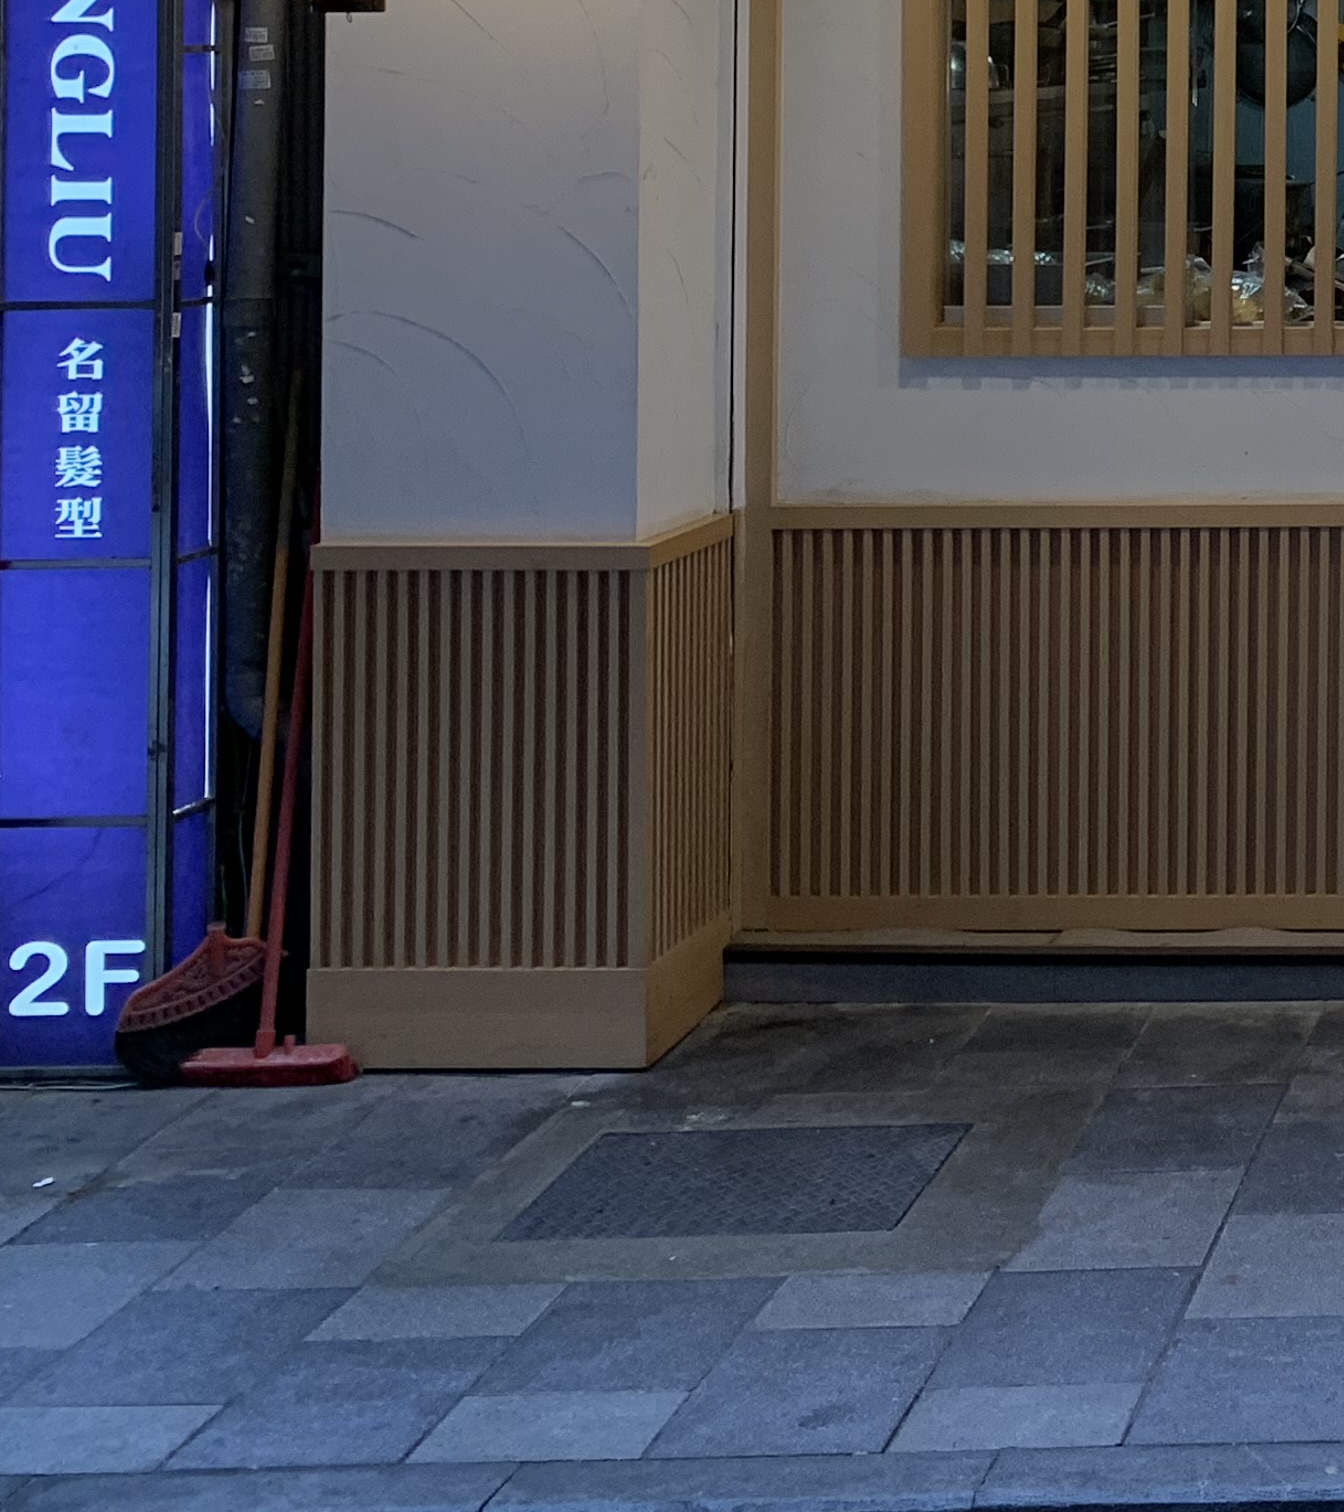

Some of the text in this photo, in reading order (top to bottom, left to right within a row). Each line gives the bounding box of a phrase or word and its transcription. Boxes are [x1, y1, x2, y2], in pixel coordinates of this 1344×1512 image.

[54, 337, 103, 538] 名留髮型
[8, 939, 146, 1017] 2F
